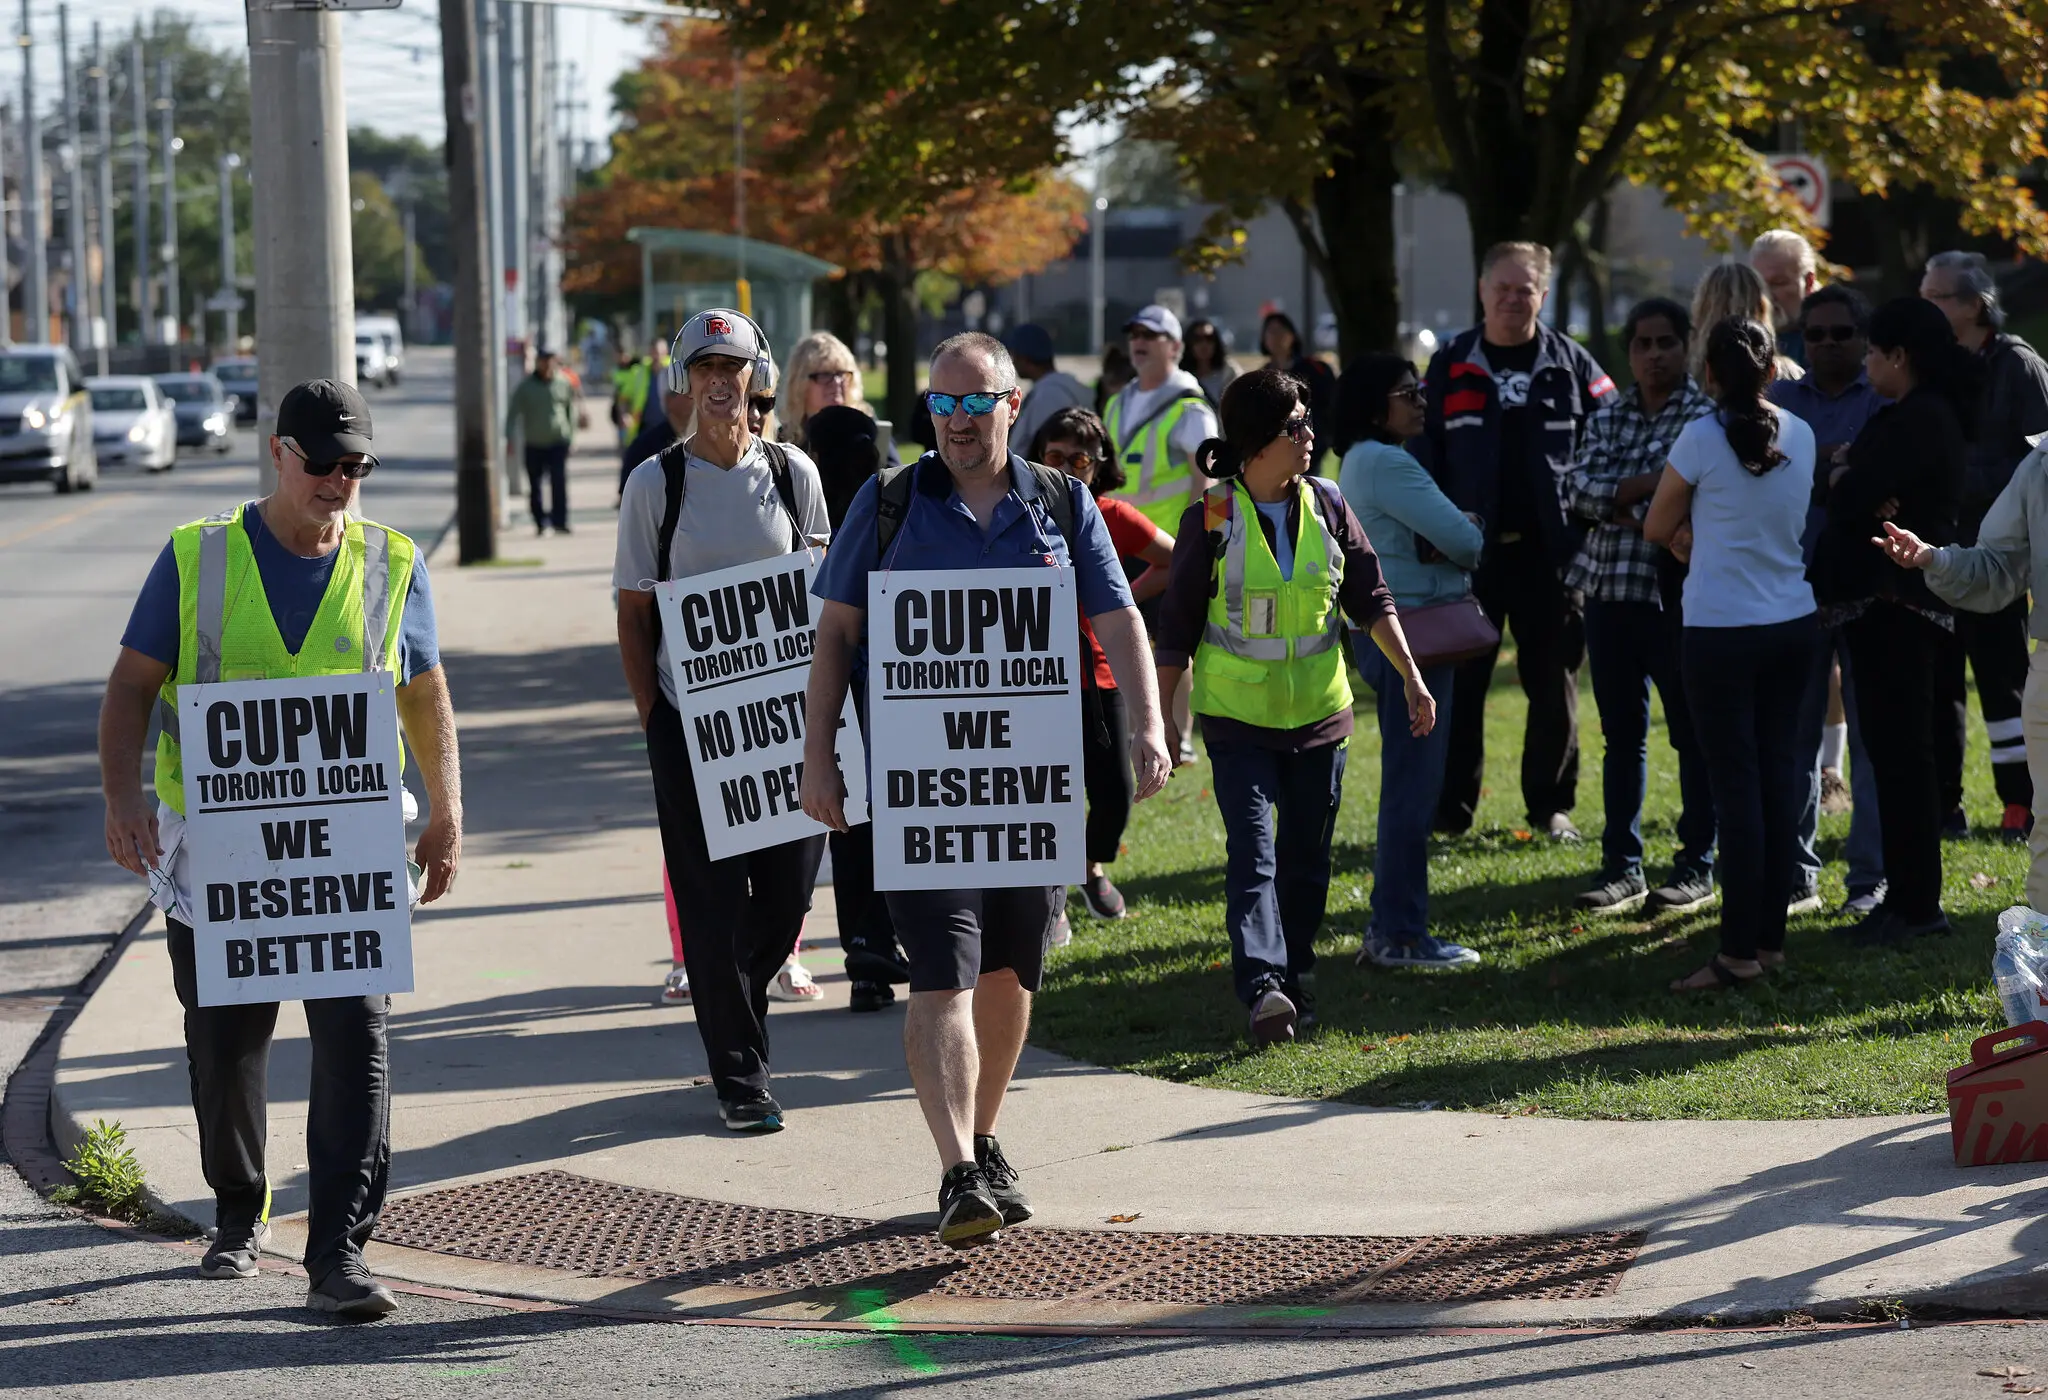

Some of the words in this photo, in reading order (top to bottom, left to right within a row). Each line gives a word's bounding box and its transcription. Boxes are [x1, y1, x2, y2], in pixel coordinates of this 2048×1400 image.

[681, 569, 810, 652] CUPW
[895, 587, 1052, 656] CUPW
[681, 642, 768, 684] TORONTO
[774, 629, 817, 663] LOCA
[882, 660, 990, 690] TORONTO
[1001, 657, 1069, 687] LOCAL
[207, 693, 368, 768] CUPW
[694, 710, 736, 762] NO
[943, 711, 1012, 749] WE
[197, 769, 307, 803] TORONTO
[317, 763, 389, 795] LOCAL
[720, 775, 761, 827] NO
[887, 765, 1072, 808] DESERVE
[261, 819, 332, 860] WE
[904, 823, 1057, 864] BETTER
[207, 872, 396, 922] DESERVE
[226, 931, 383, 978] BETTER
